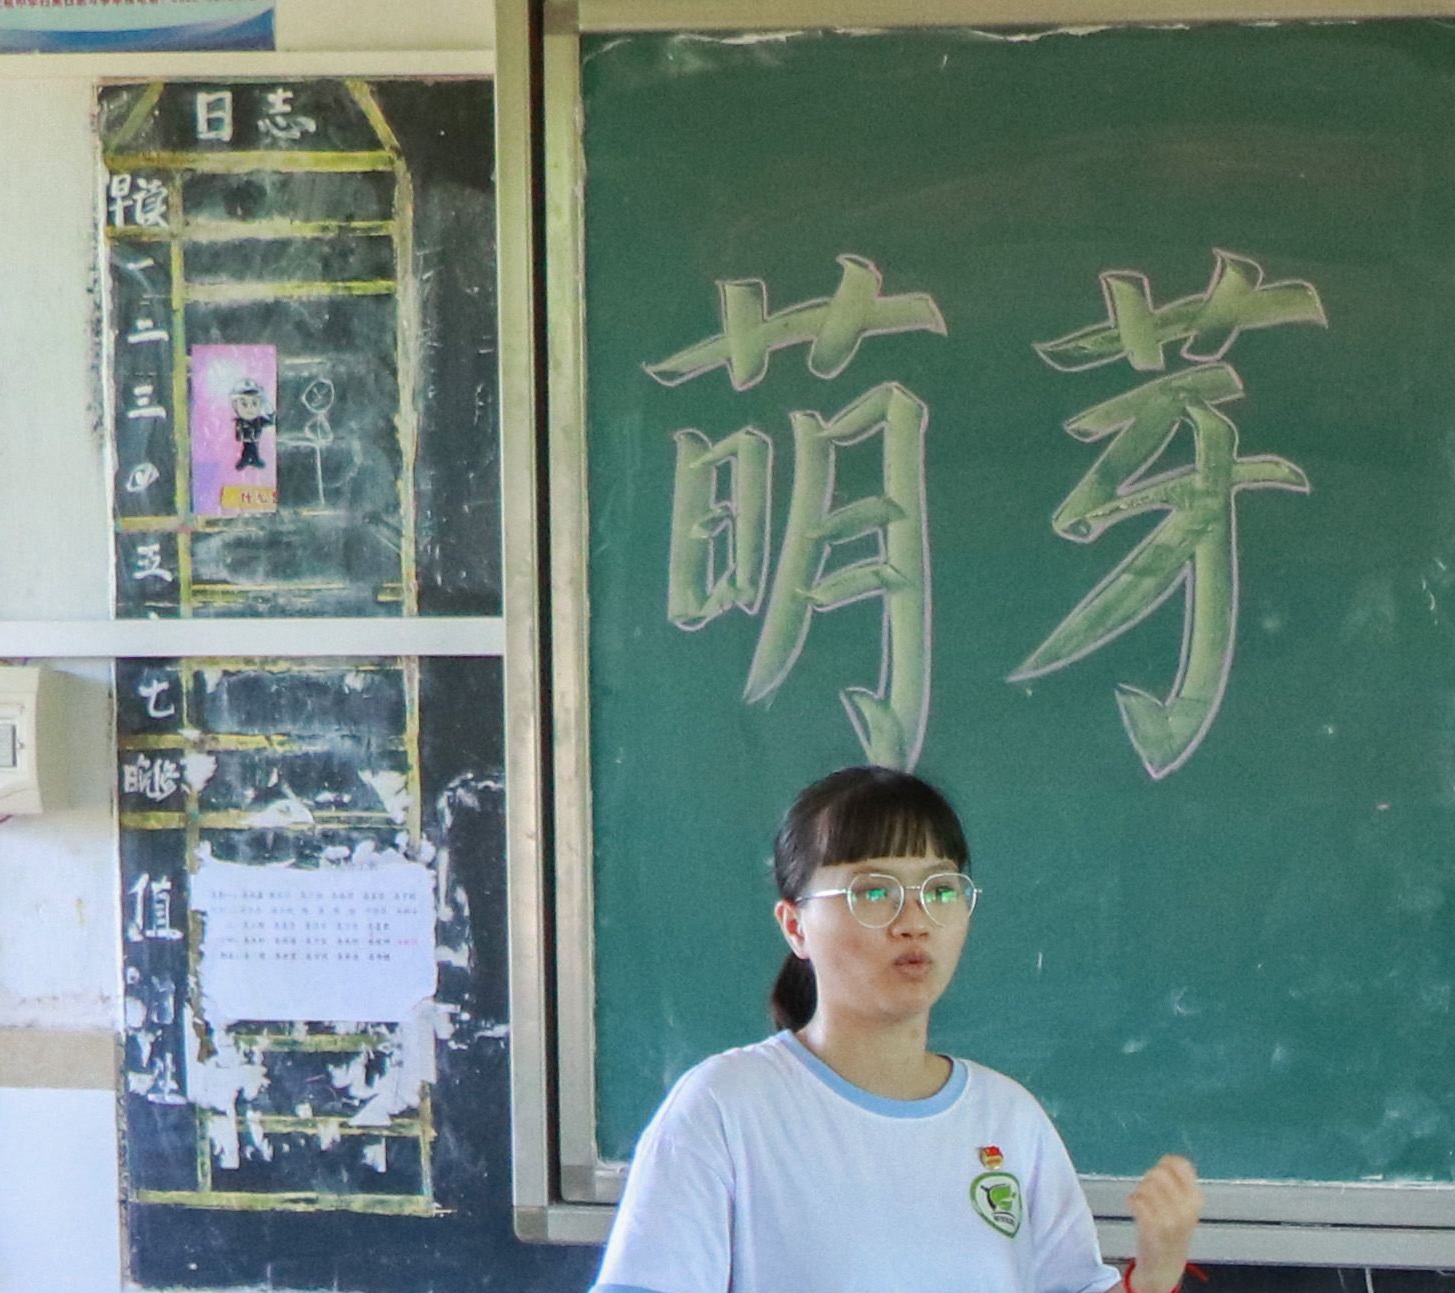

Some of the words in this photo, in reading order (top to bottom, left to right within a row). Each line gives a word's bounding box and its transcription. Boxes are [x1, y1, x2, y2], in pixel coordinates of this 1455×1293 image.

[195, 88, 317, 143] 日志
[108, 173, 169, 228] 早读
[127, 384, 167, 419] 三
[641, 248, 1329, 780] 萌芽
[132, 543, 174, 583] 五
